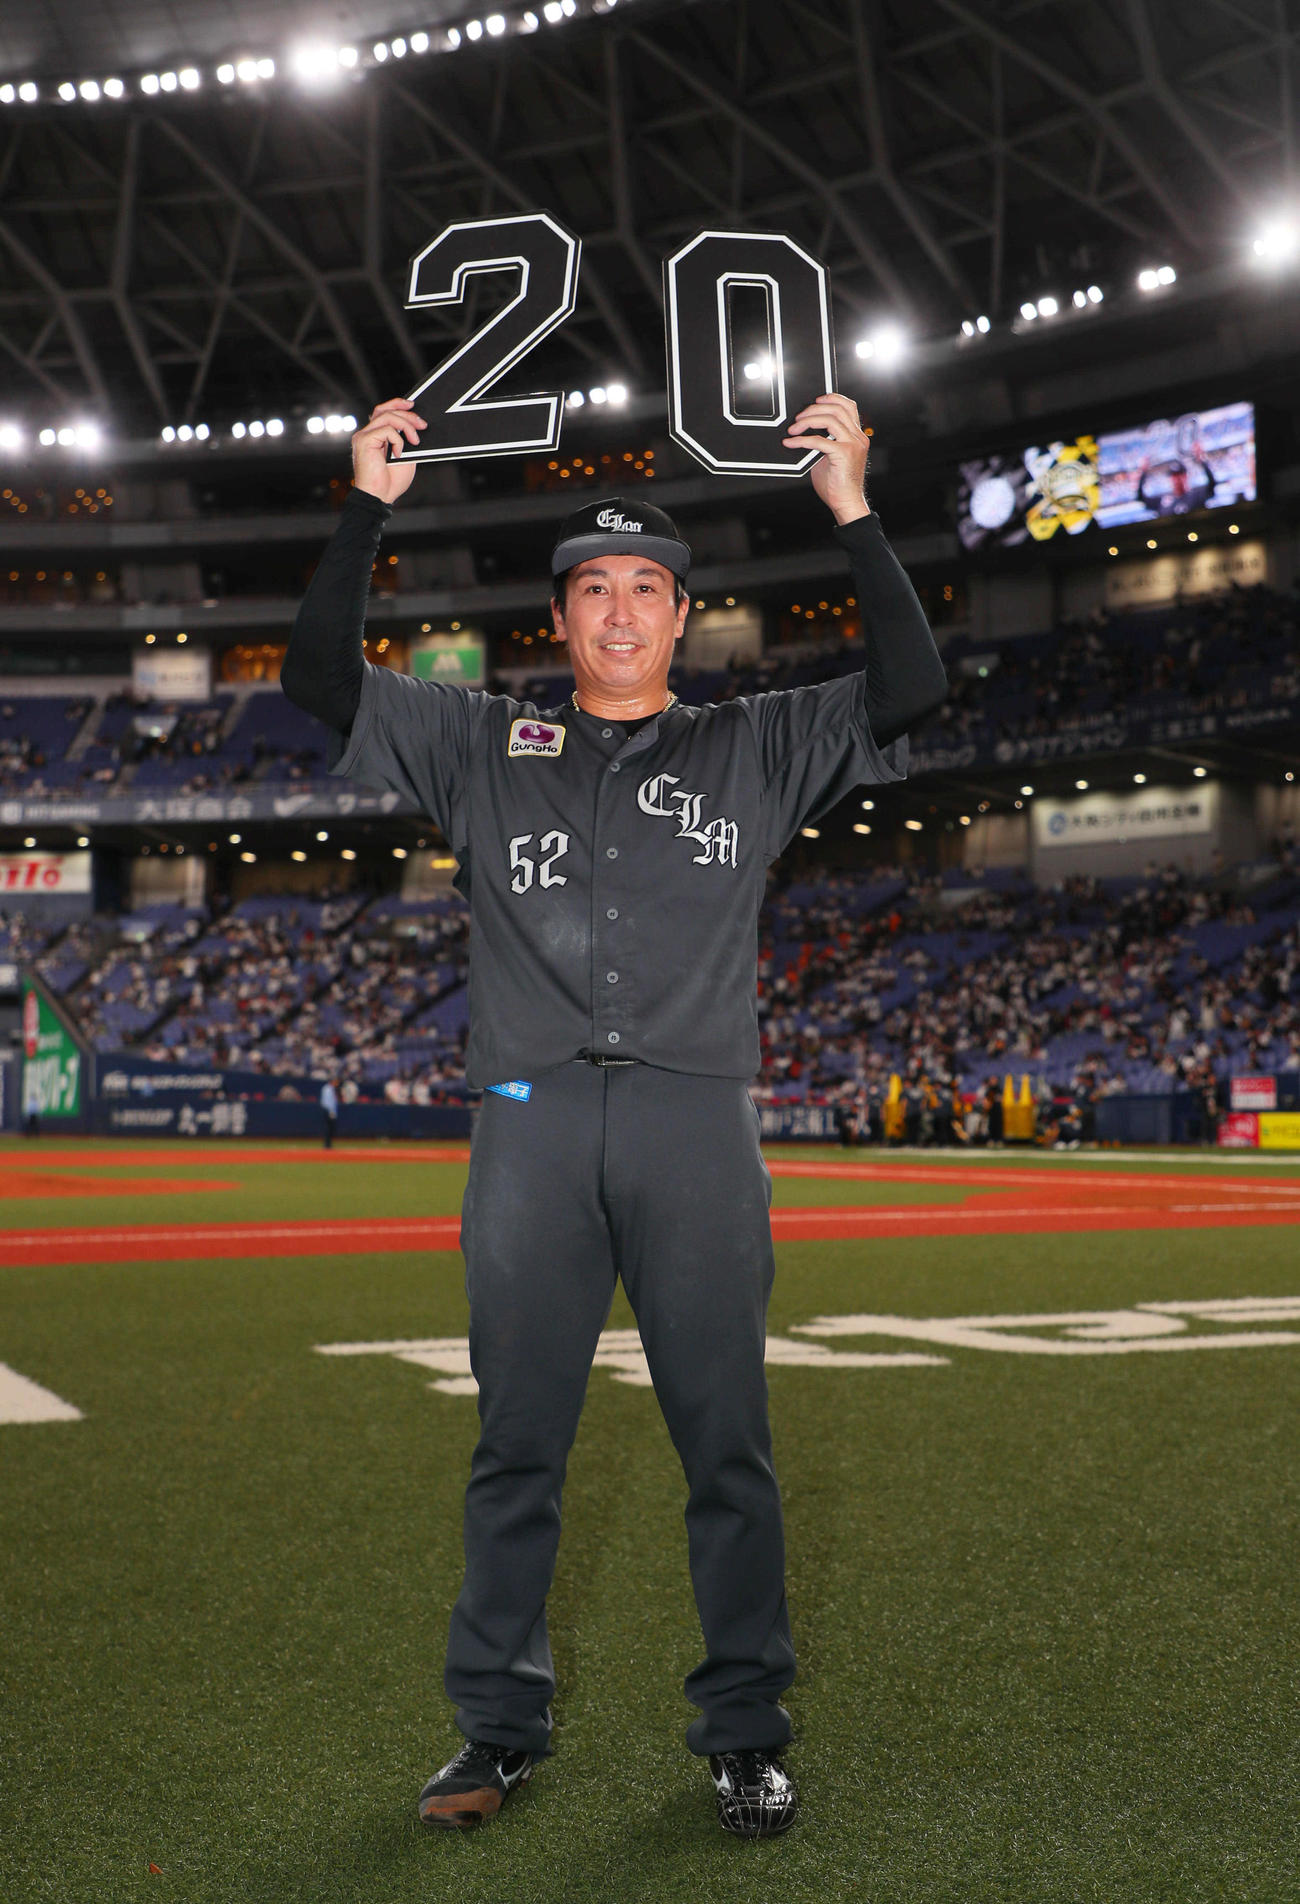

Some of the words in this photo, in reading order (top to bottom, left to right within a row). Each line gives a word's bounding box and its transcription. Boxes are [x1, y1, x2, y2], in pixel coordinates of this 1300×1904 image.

[387, 209, 838, 478] 20
[511, 742, 558, 753] GungHo
[508, 830, 570, 895] 52
